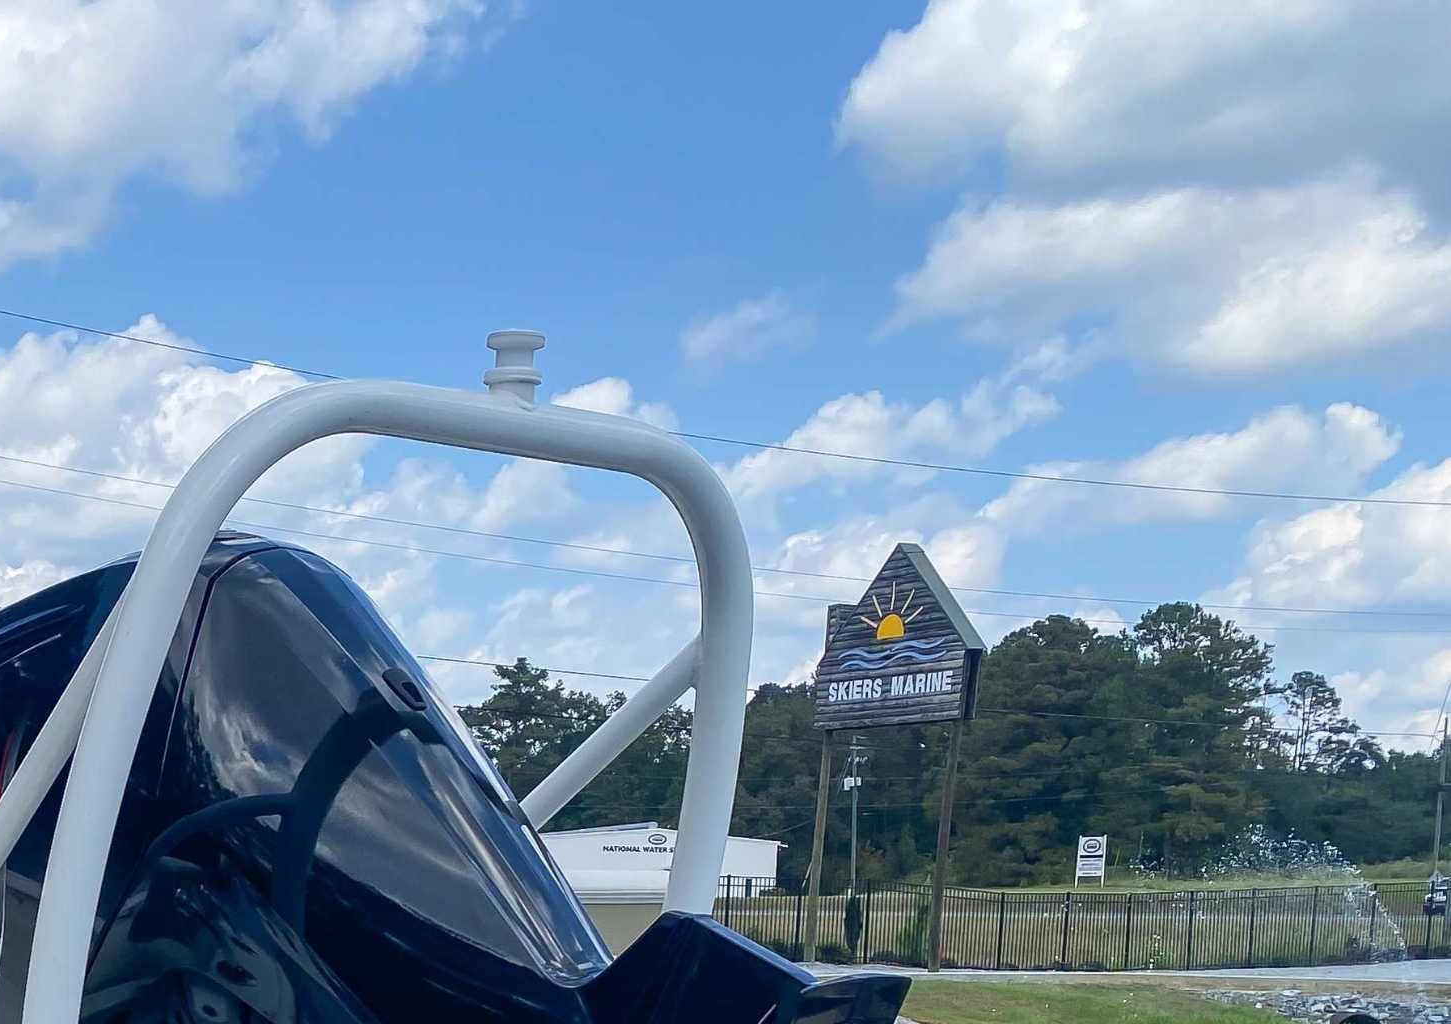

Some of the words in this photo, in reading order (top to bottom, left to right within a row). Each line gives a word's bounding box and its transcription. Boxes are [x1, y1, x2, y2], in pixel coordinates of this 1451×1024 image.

[829, 678, 882, 702] SKIERS
[890, 671, 953, 697] MARINE
[603, 845, 641, 853] NATIONAL
